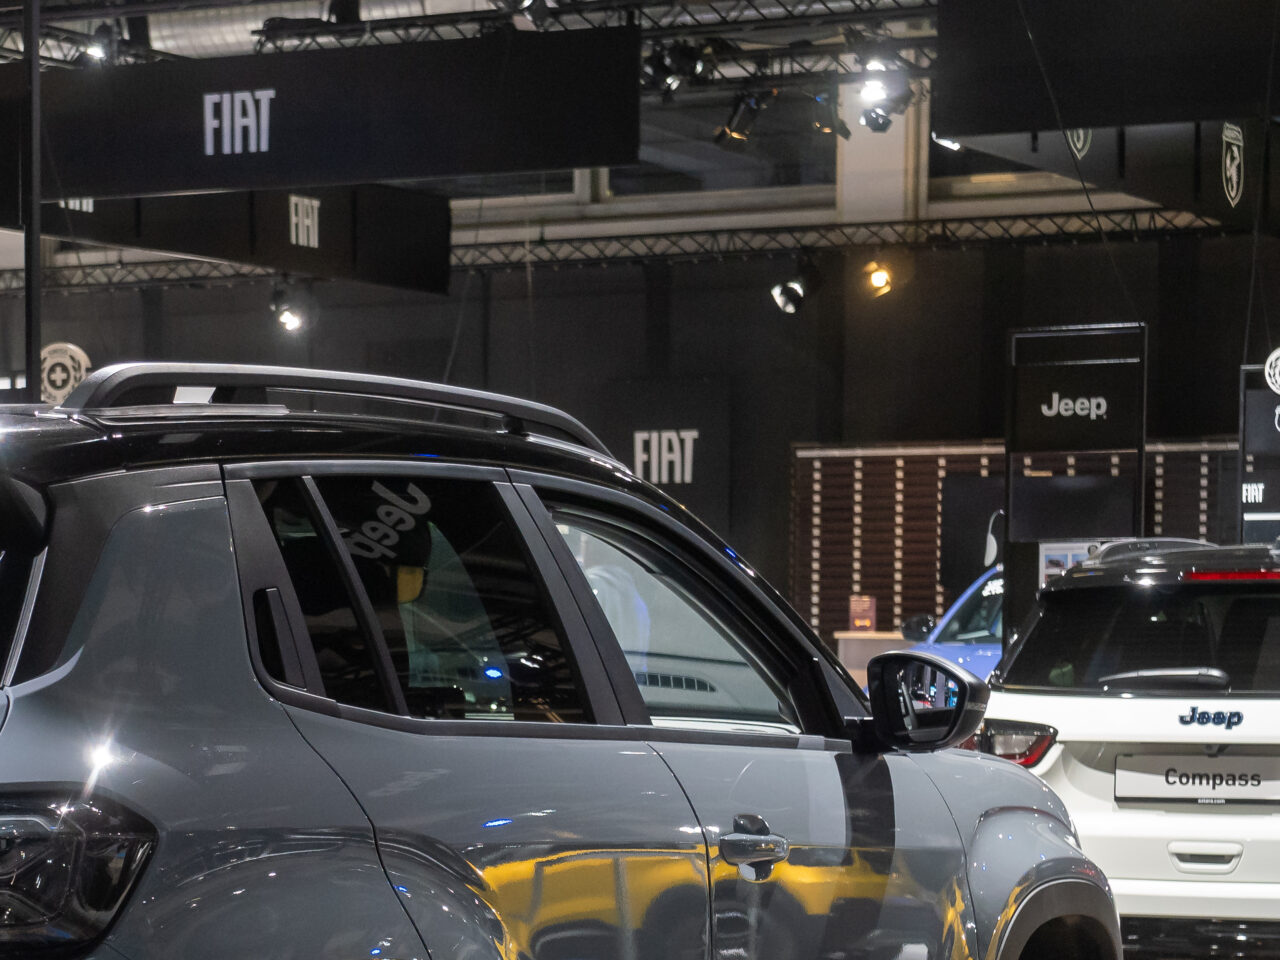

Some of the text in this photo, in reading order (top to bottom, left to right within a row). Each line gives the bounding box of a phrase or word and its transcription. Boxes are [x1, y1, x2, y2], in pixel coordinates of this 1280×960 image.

[203, 89, 276, 156] FIAT
[289, 194, 321, 249] FIAT
[1041, 391, 1108, 420] Jeep
[633, 429, 700, 485] FIAT
[1241, 482, 1265, 504] FIAT
[1178, 706, 1244, 730] Jeep
[1164, 767, 1262, 790] Compass
